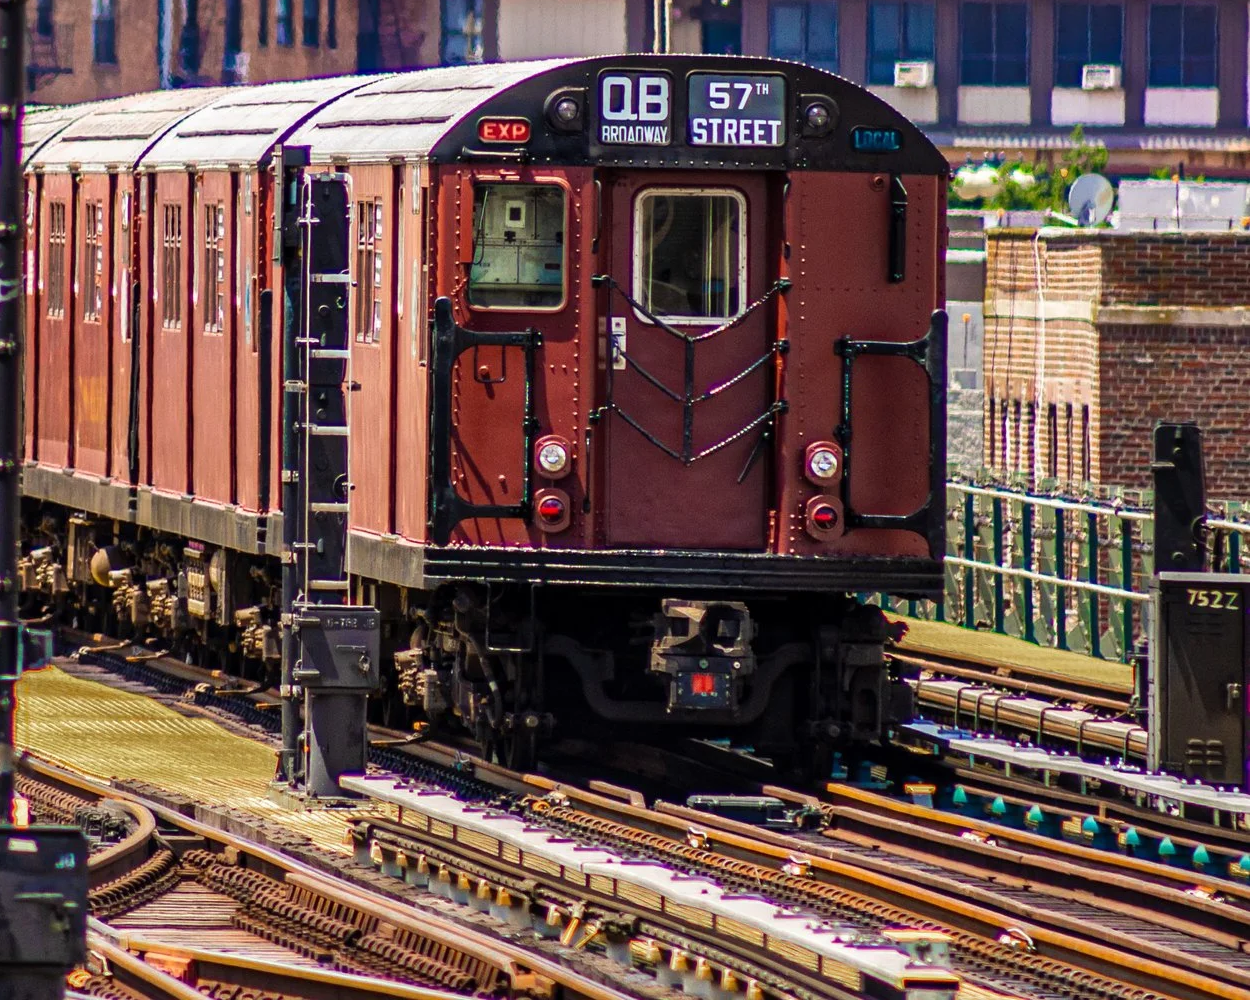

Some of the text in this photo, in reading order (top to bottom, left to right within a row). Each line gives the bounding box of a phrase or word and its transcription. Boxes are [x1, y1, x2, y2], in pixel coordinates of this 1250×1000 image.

[602, 76, 669, 121] QB
[482, 124, 526, 139] EXP
[602, 125, 668, 144] BROADWAY
[693, 117, 782, 146] STREET
[854, 130, 900, 150] LOCAL
